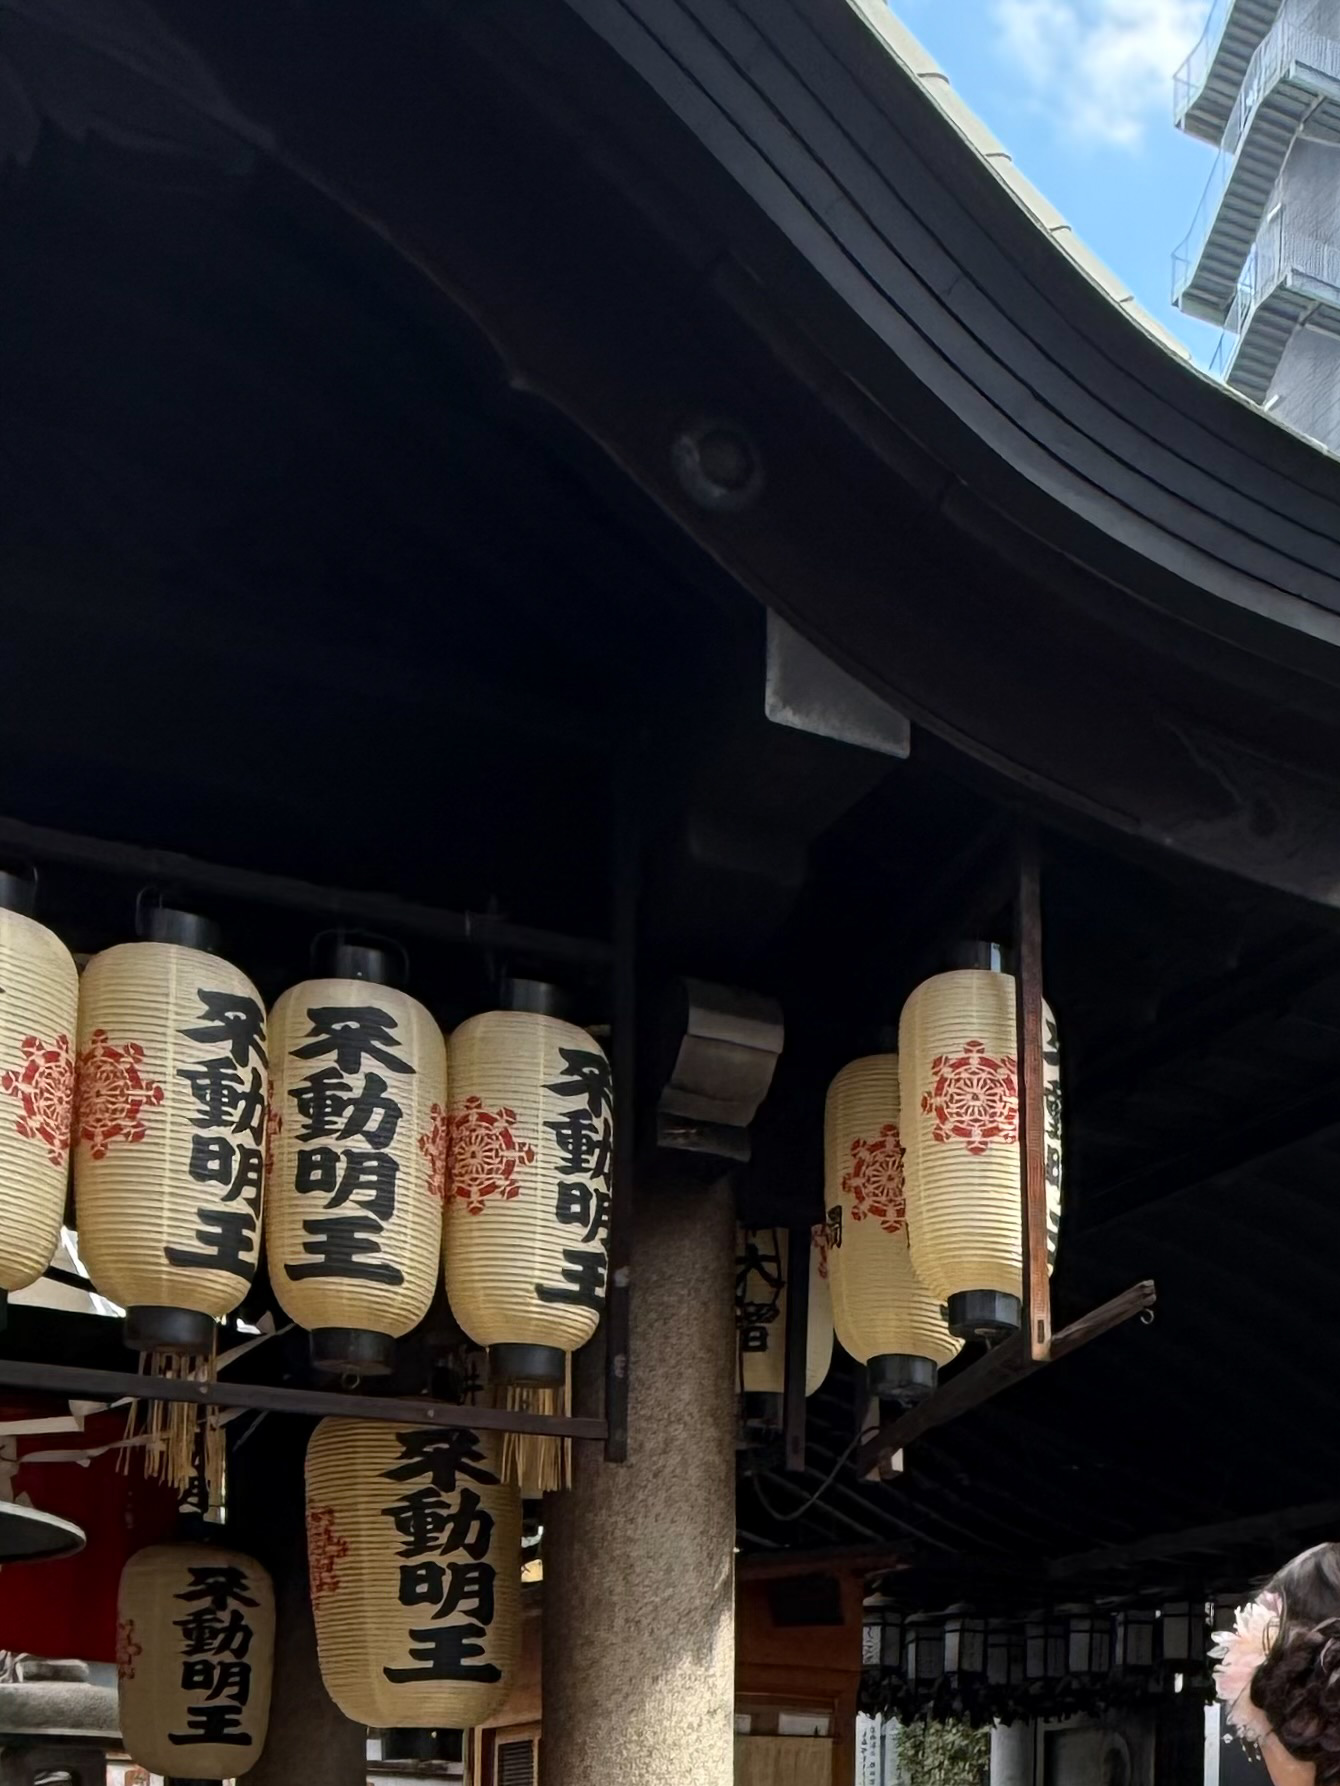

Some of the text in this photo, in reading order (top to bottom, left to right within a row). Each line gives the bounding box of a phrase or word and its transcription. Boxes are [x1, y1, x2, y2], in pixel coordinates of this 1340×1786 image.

[164, 988, 269, 1286] 不動明王
[285, 1005, 416, 1286] 不動明王
[535, 1046, 614, 1308] 不動明王
[167, 1565, 261, 1746] 不動明王
[379, 1428, 502, 1684] 不動明王
